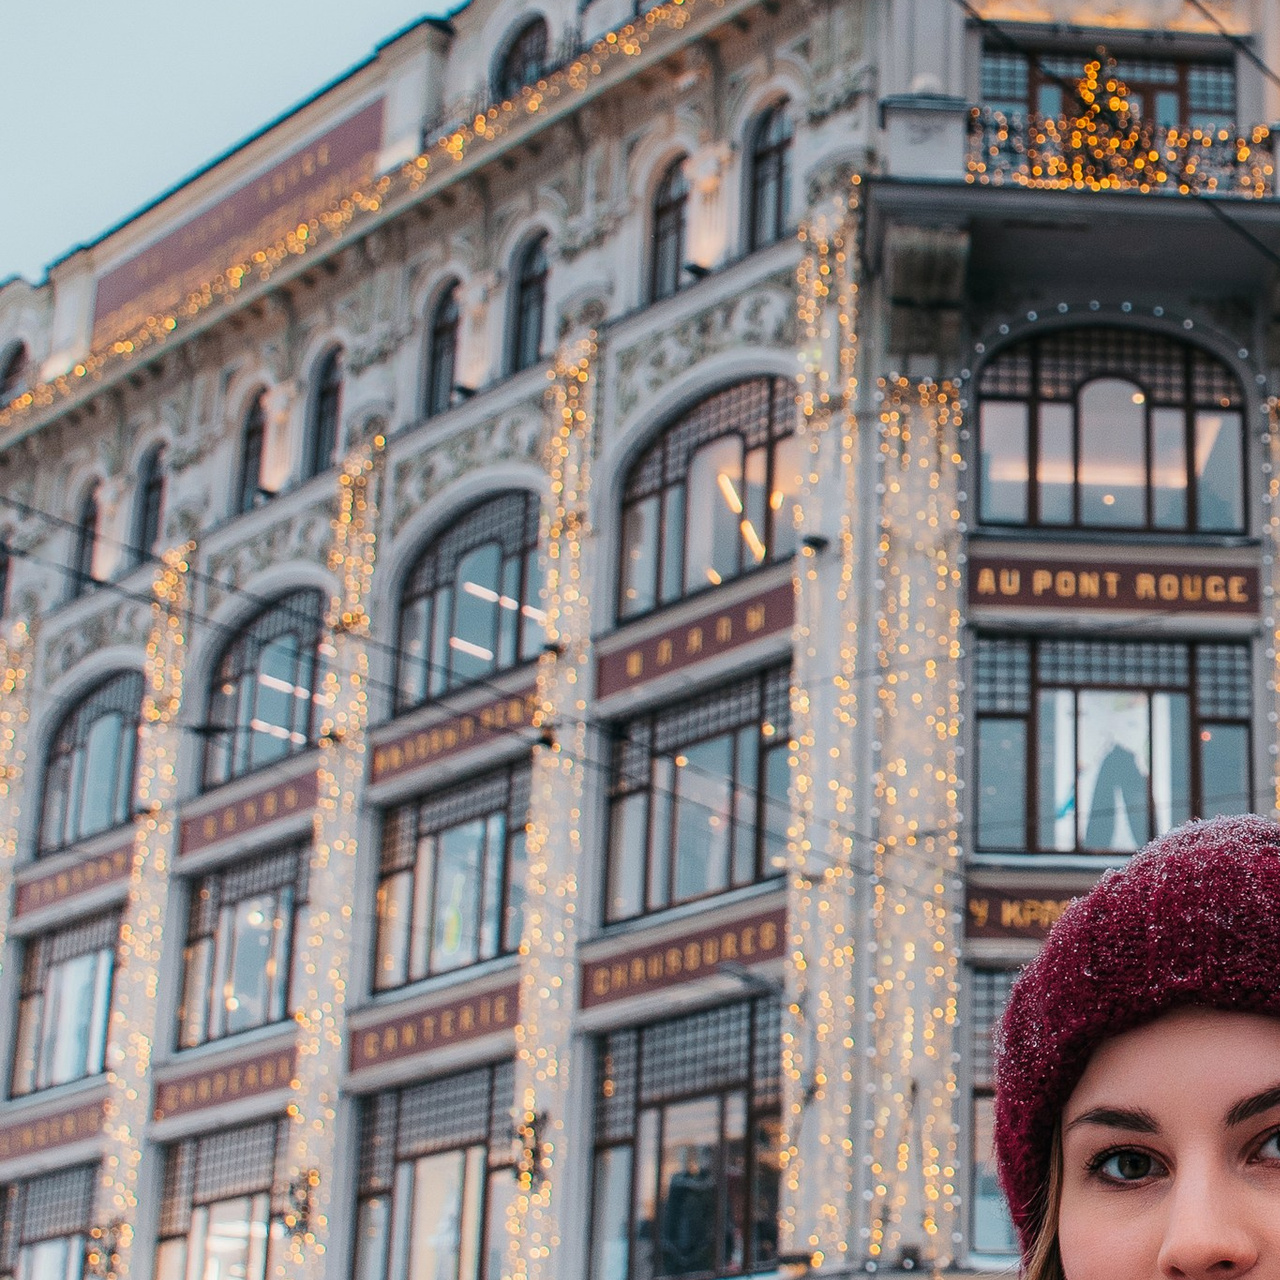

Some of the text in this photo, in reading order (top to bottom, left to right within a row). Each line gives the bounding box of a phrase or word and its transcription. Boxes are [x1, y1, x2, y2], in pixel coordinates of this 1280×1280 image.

[977, 567, 1249, 604] AU PONT ROUGE
[592, 920, 778, 997] CHAUSSURES
